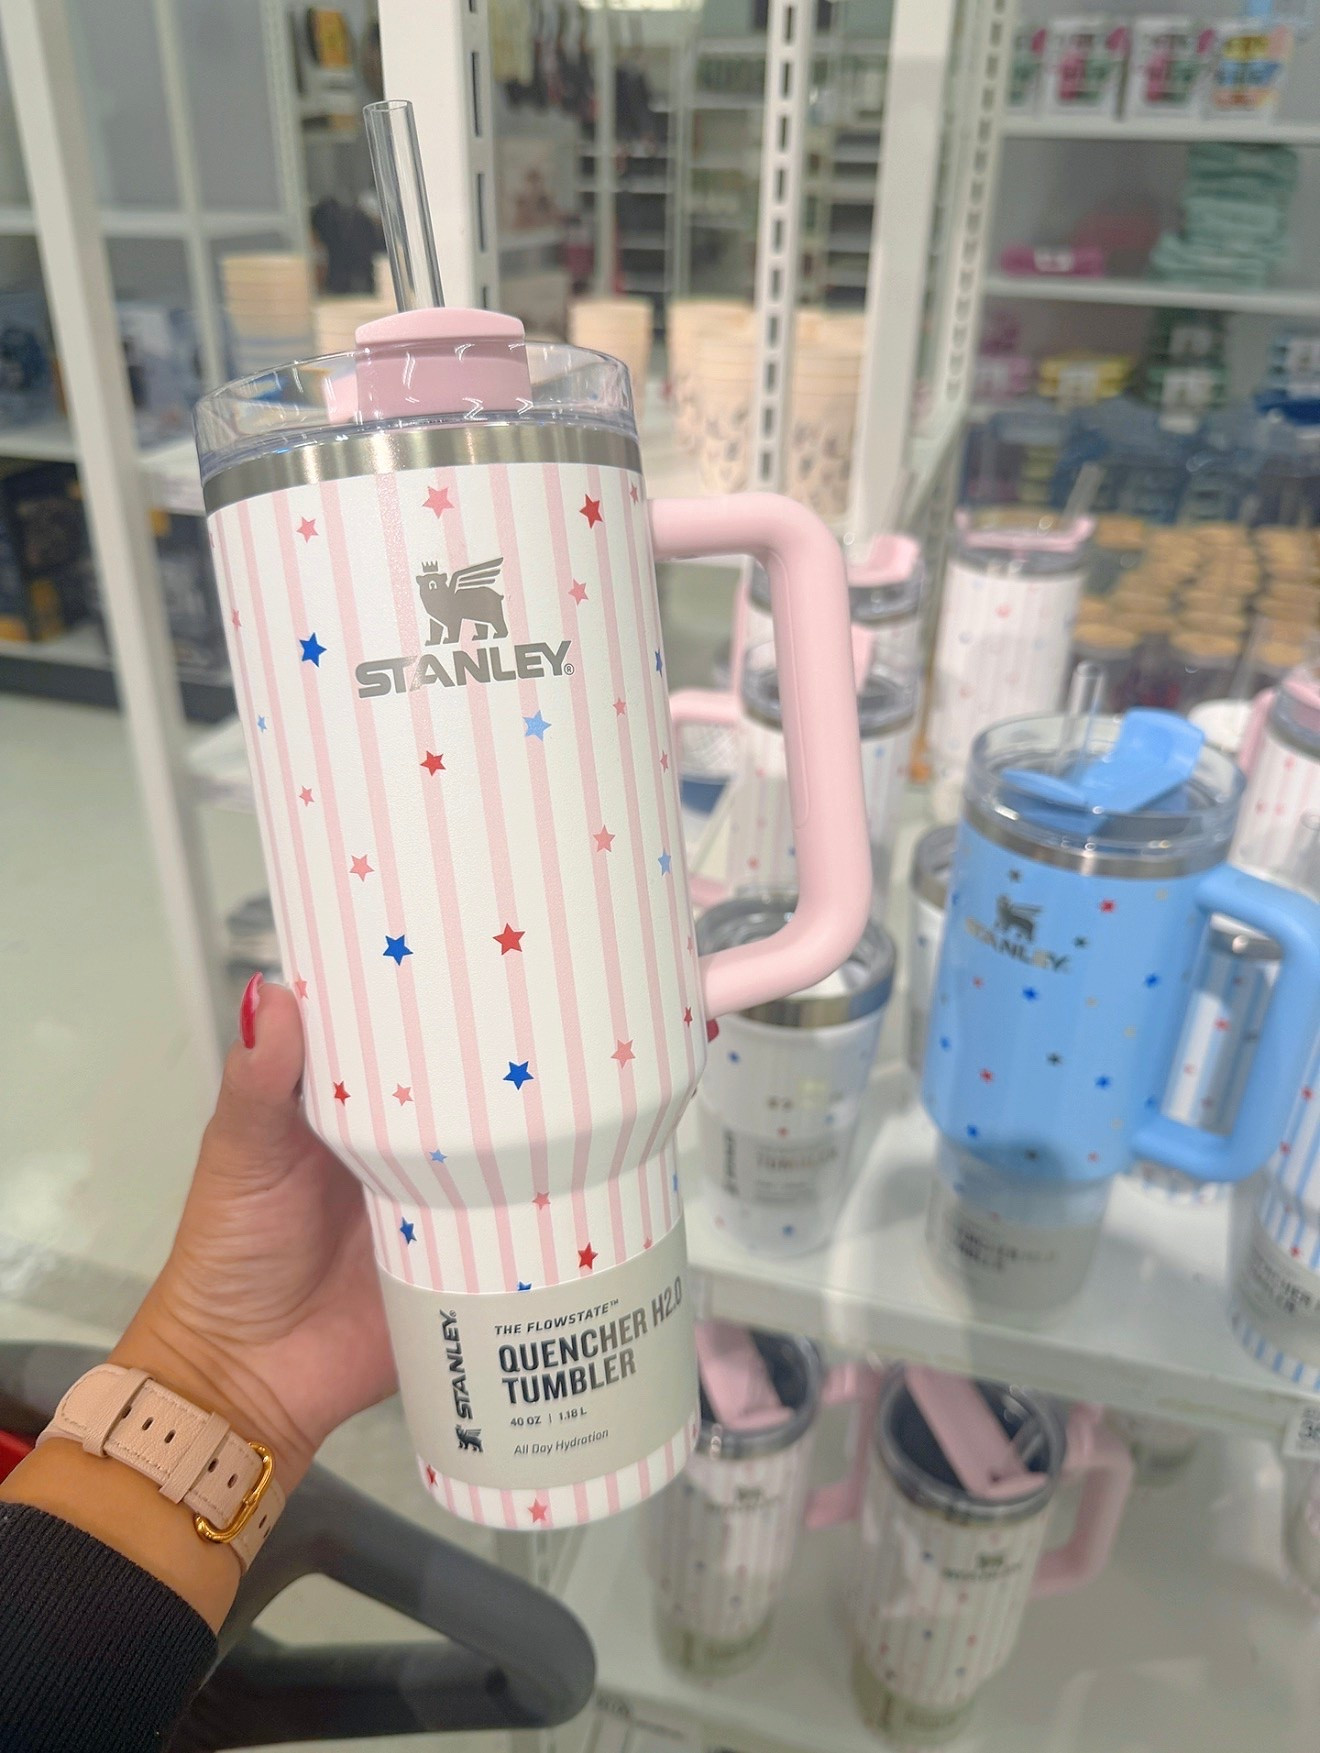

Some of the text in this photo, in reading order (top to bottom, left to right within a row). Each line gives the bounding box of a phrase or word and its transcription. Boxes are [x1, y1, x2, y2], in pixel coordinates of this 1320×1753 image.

[495, 1323, 522, 1336] THE
[498, 1275, 683, 1373] QUENCHER H2.0
[501, 1347, 637, 1405] TUMBLER
[510, 1405, 588, 1427] 40 OZ 1.18 L
[513, 1427, 609, 1456] All Day Hydration
